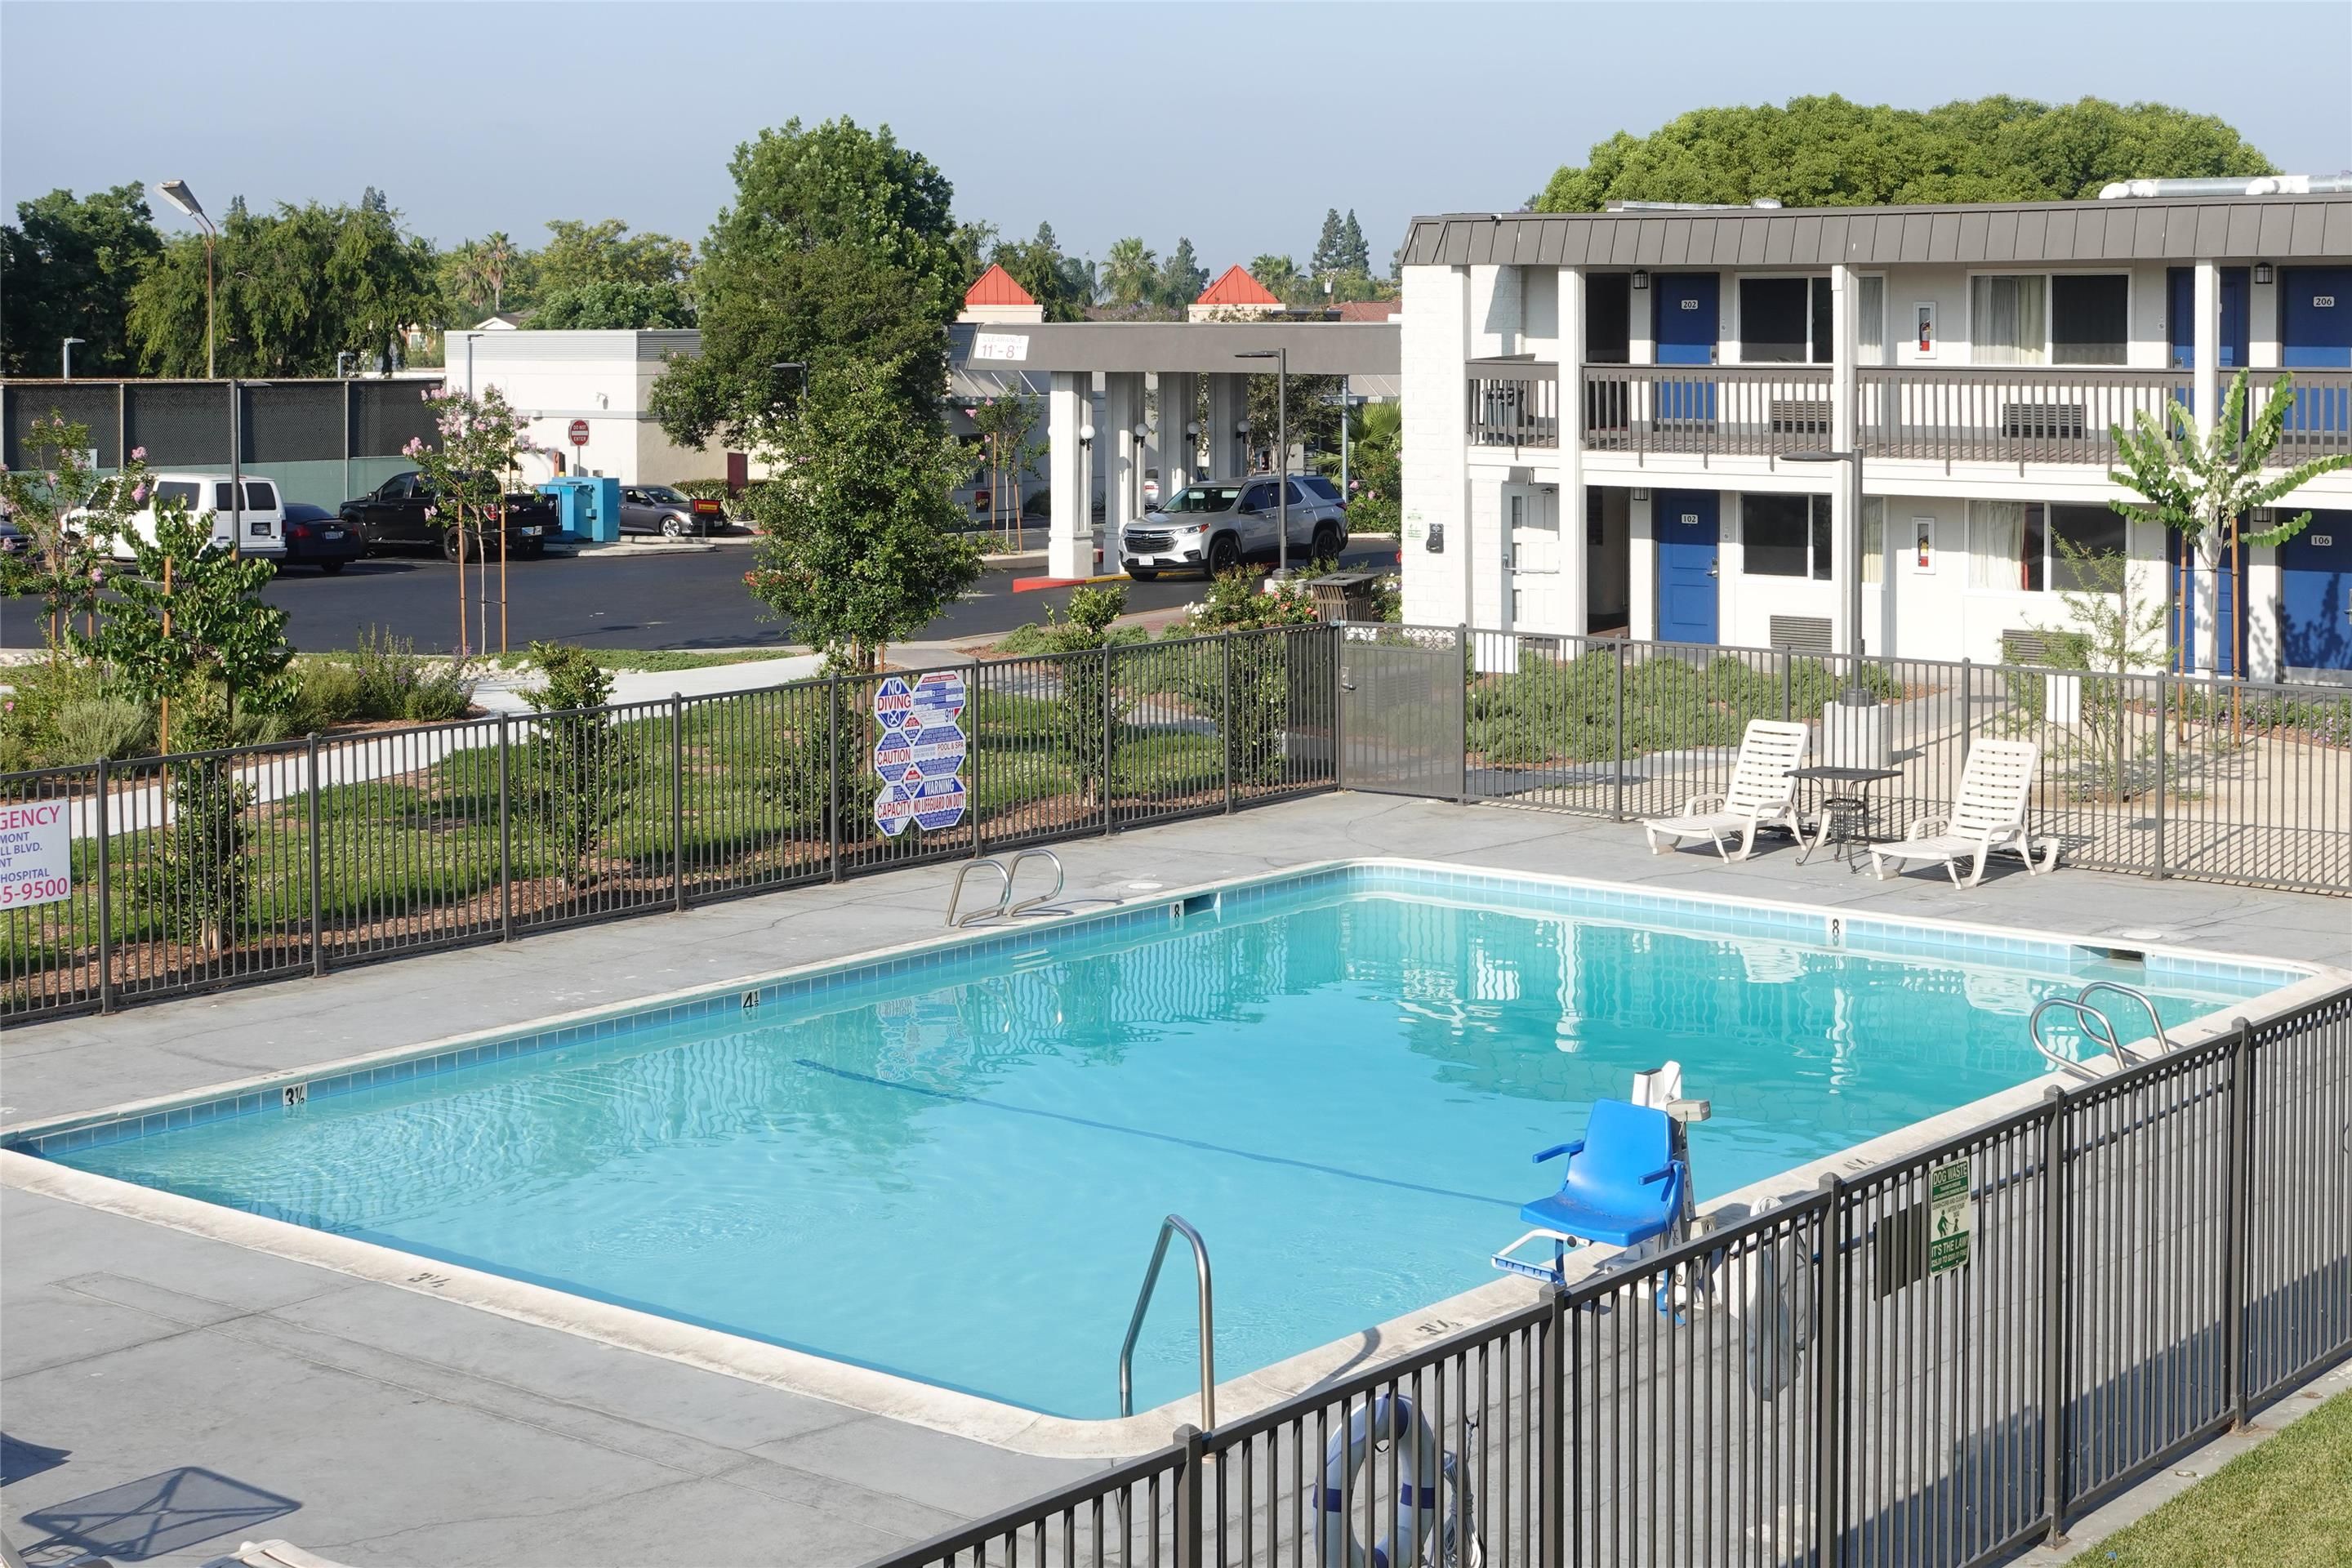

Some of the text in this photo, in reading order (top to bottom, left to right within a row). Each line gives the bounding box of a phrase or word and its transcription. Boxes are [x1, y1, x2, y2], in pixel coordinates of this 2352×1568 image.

[1683, 301, 1696, 309] 202
[2315, 297, 2332, 306] 206
[2314, 536, 2330, 545] 106
[888, 680, 902, 695] NO
[878, 694, 911, 711] DIVING
[945, 708, 954, 723] 911
[937, 742, 950, 751] POOL
[955, 740, 964, 749] SPA
[877, 748, 911, 765] CAUTION
[924, 777, 955, 796] WARNING
[893, 792, 907, 801] POOL
[914, 792, 964, 813] NO LIFEGUARD ON DUTY
[877, 800, 911, 818] CAPACITY
[886, 822, 894, 831] SPA
[14, 842, 42, 854] BLVD.
[1, 868, 50, 883] HOSPITAL
[0, 877, 68, 903] 5-9500
[1933, 1162, 1967, 1185] DOG WASTE
[1931, 1244, 1942, 1258] IT'S
[1943, 1240, 1954, 1254] THE
